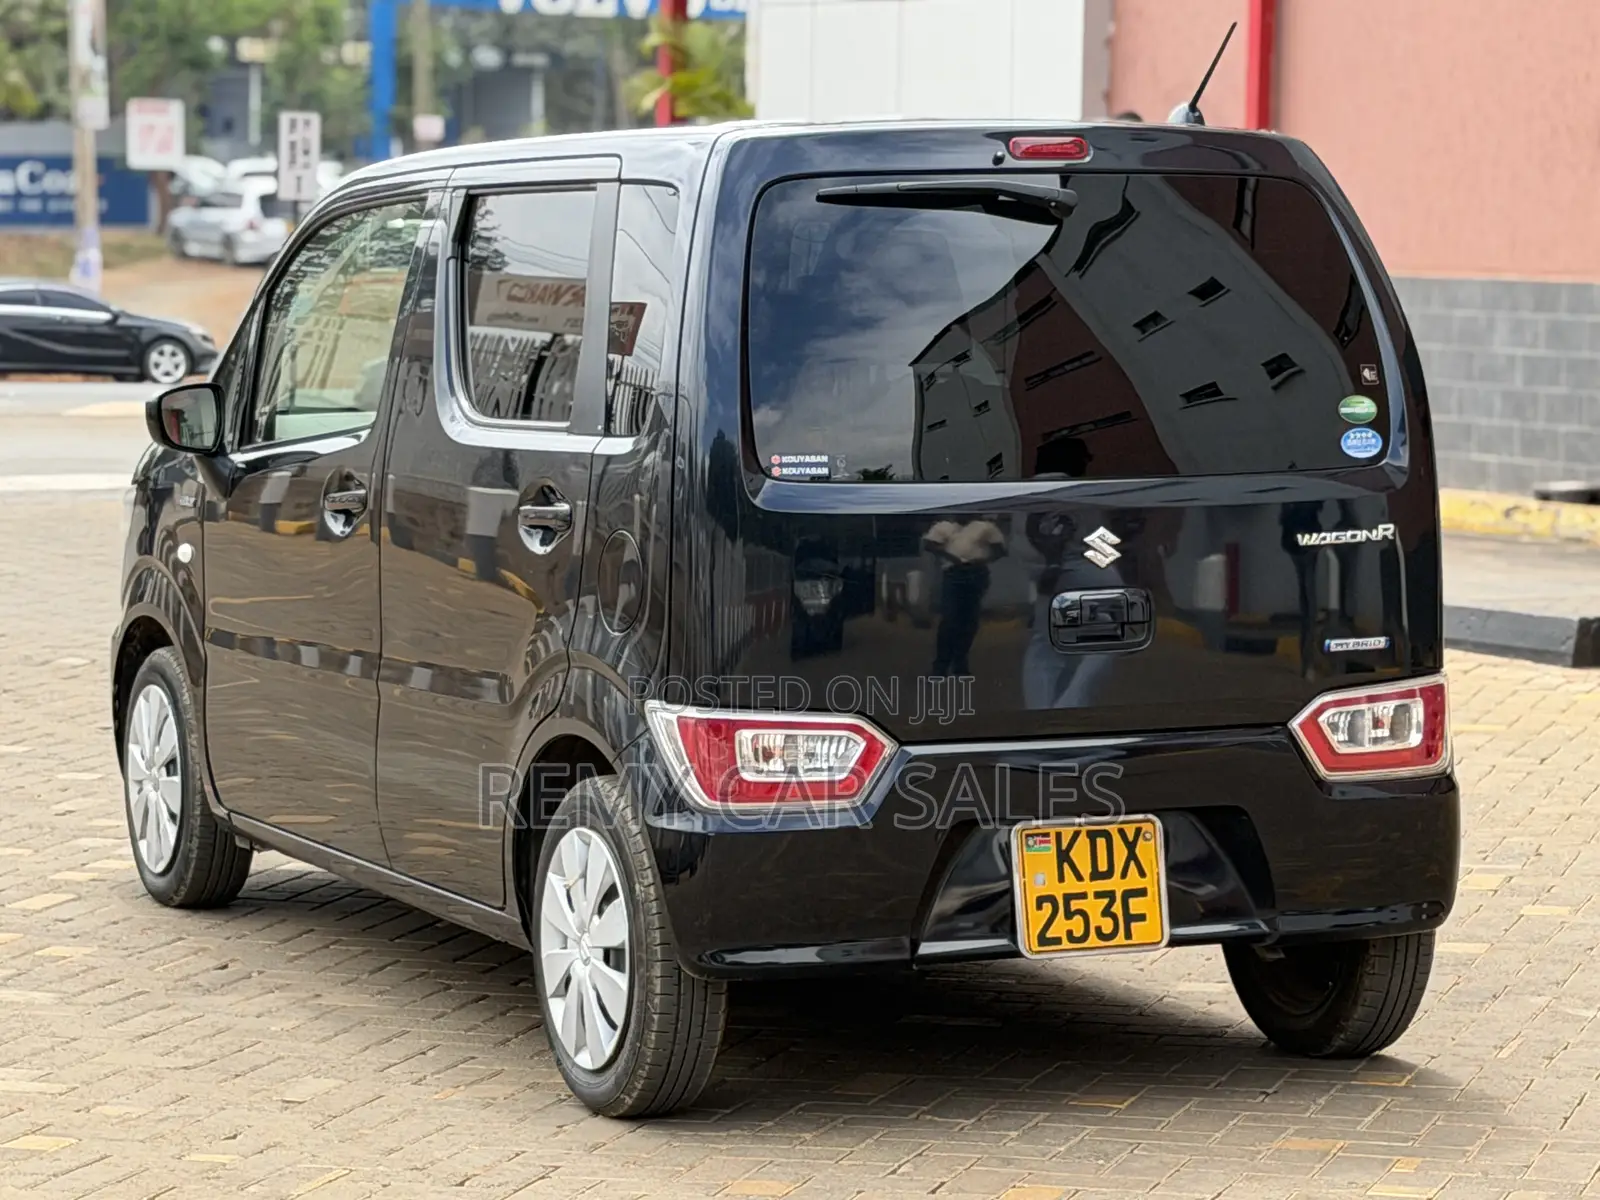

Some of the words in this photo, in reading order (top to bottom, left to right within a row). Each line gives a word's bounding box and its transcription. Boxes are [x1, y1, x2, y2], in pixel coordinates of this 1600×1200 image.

[781, 454, 829, 464] KOUYASAN
[781, 466, 829, 475] KOUYASAN
[1054, 826, 1147, 884] KDX
[1035, 886, 1148, 947] 253F
